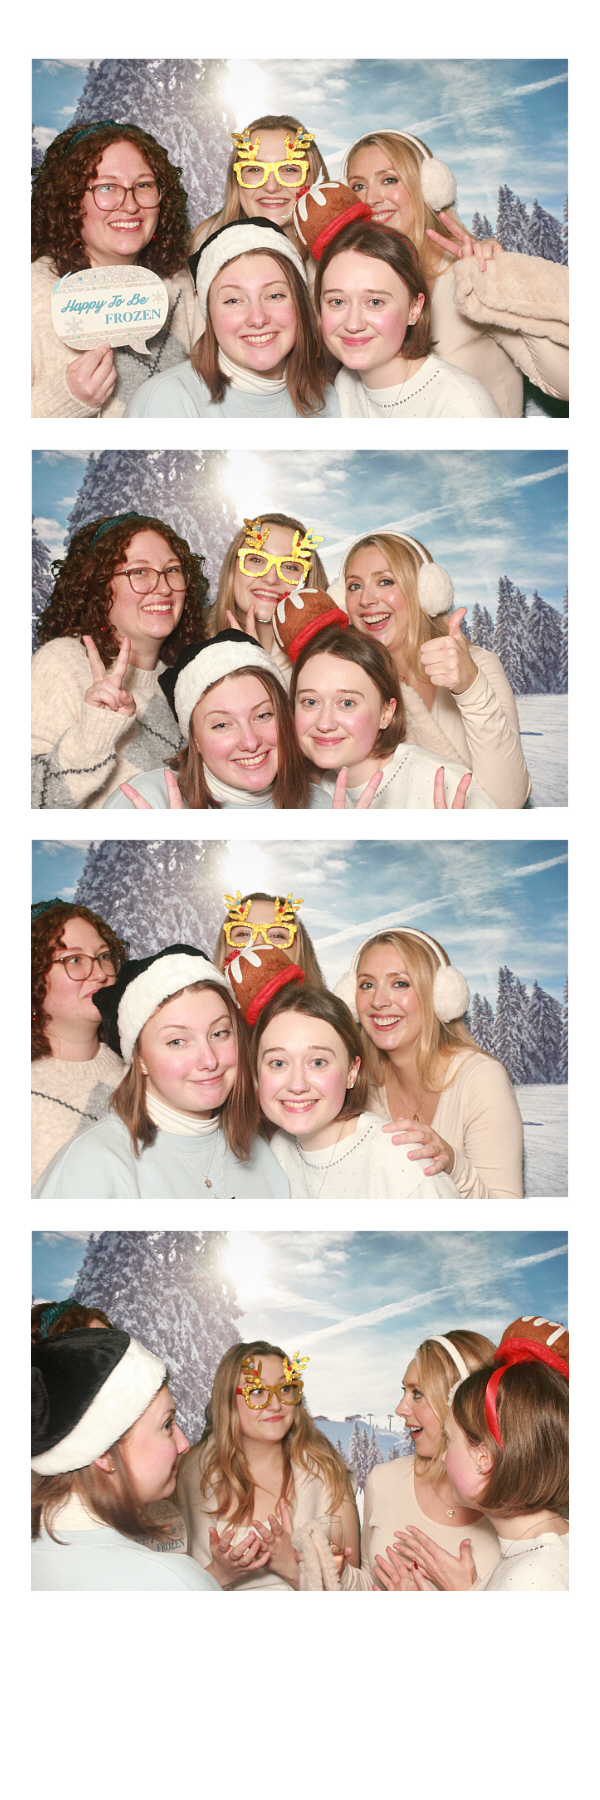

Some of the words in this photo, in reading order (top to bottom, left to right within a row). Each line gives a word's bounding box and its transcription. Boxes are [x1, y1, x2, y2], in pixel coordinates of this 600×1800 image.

[61, 299, 107, 315] Happy
[108, 295, 125, 308] To
[127, 293, 149, 306] Be
[105, 308, 161, 325] FROZEN
[156, 1538, 185, 1552] FROZEN
